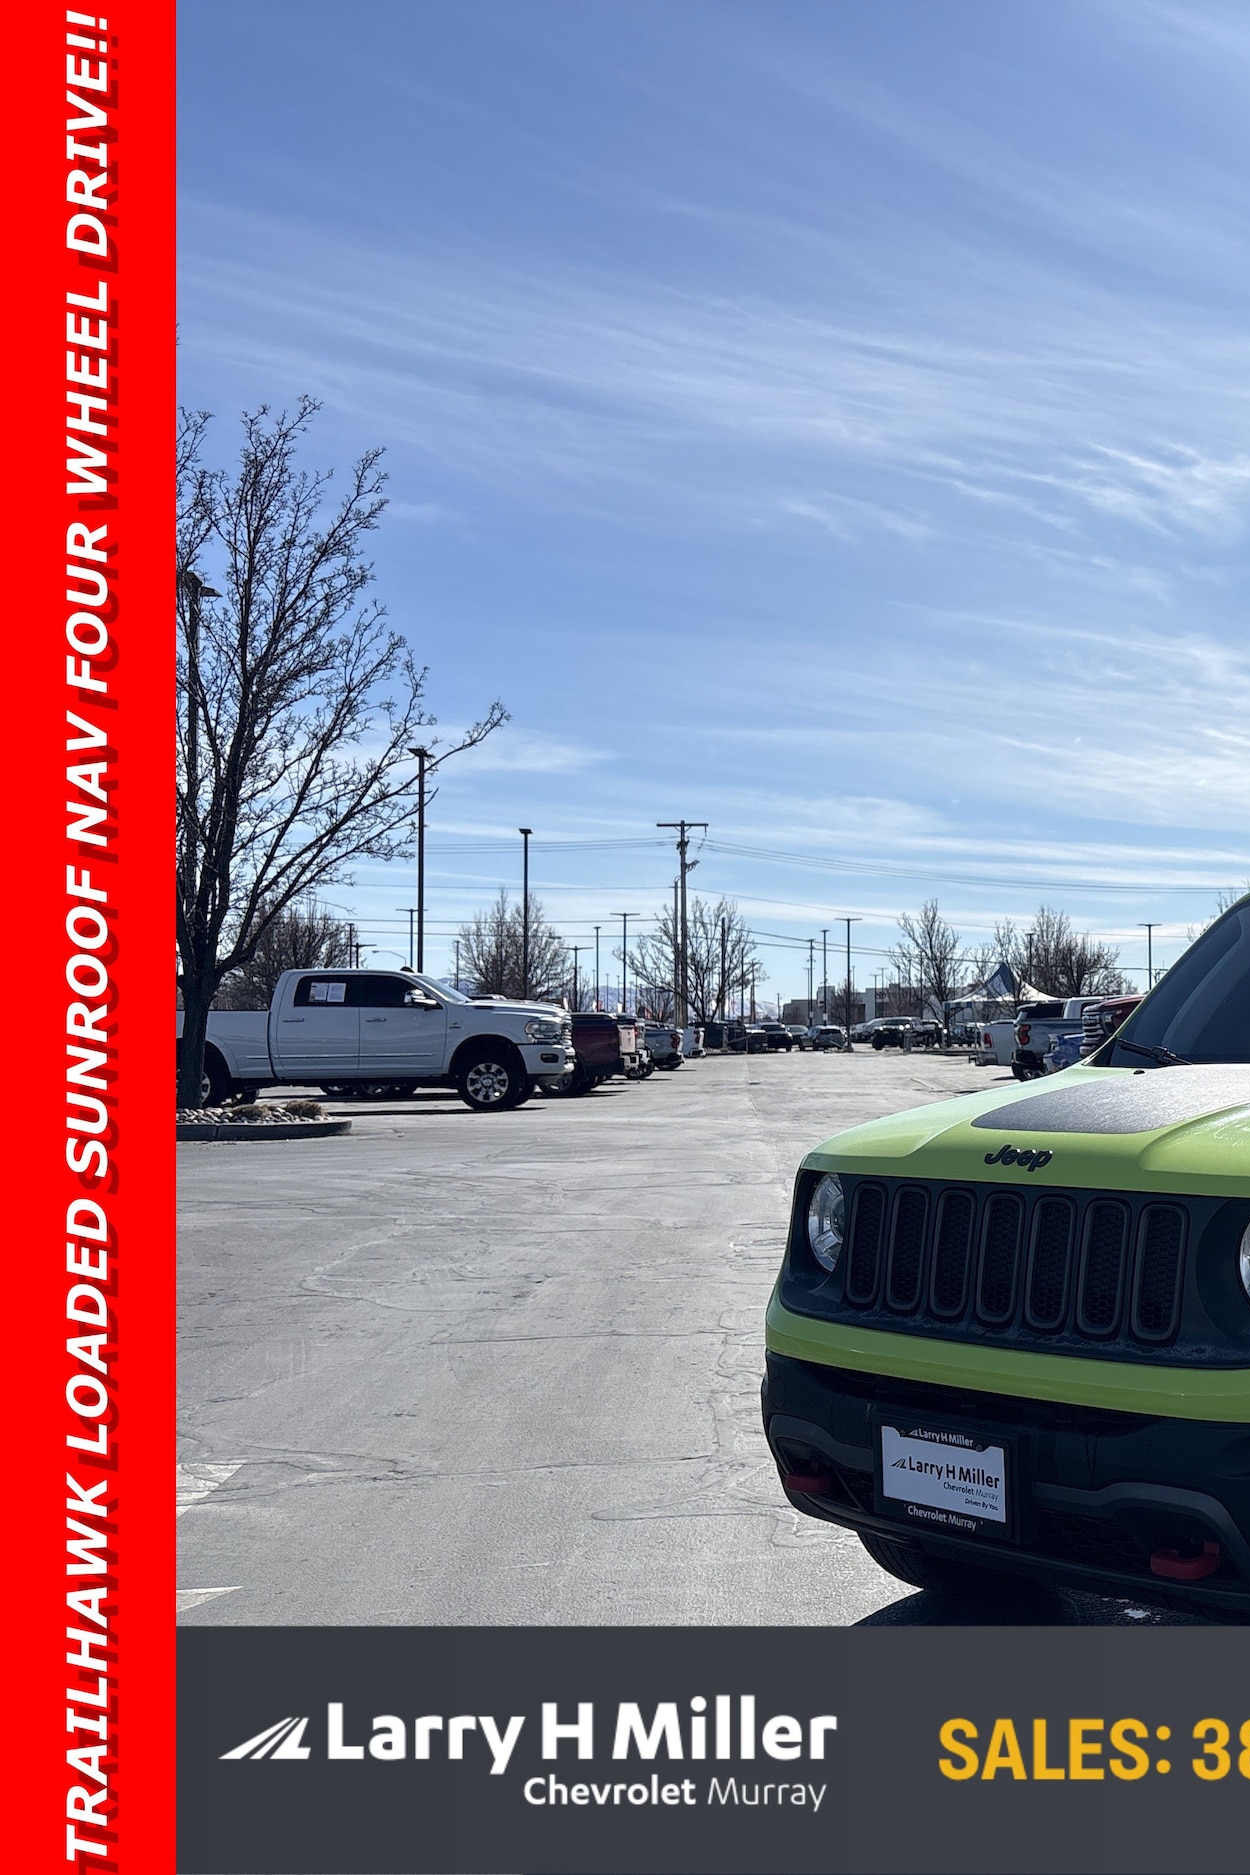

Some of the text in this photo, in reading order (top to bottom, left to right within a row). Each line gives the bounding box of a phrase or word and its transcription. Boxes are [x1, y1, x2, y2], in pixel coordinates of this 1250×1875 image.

[984, 1144, 1053, 1173] Jeep
[919, 1428, 974, 1447] Larry H Miller
[908, 1456, 1000, 1489] Larry H Miller
[943, 1481, 999, 1502] Chevrolet Murray
[907, 1505, 977, 1531] Chevrolet Murray
